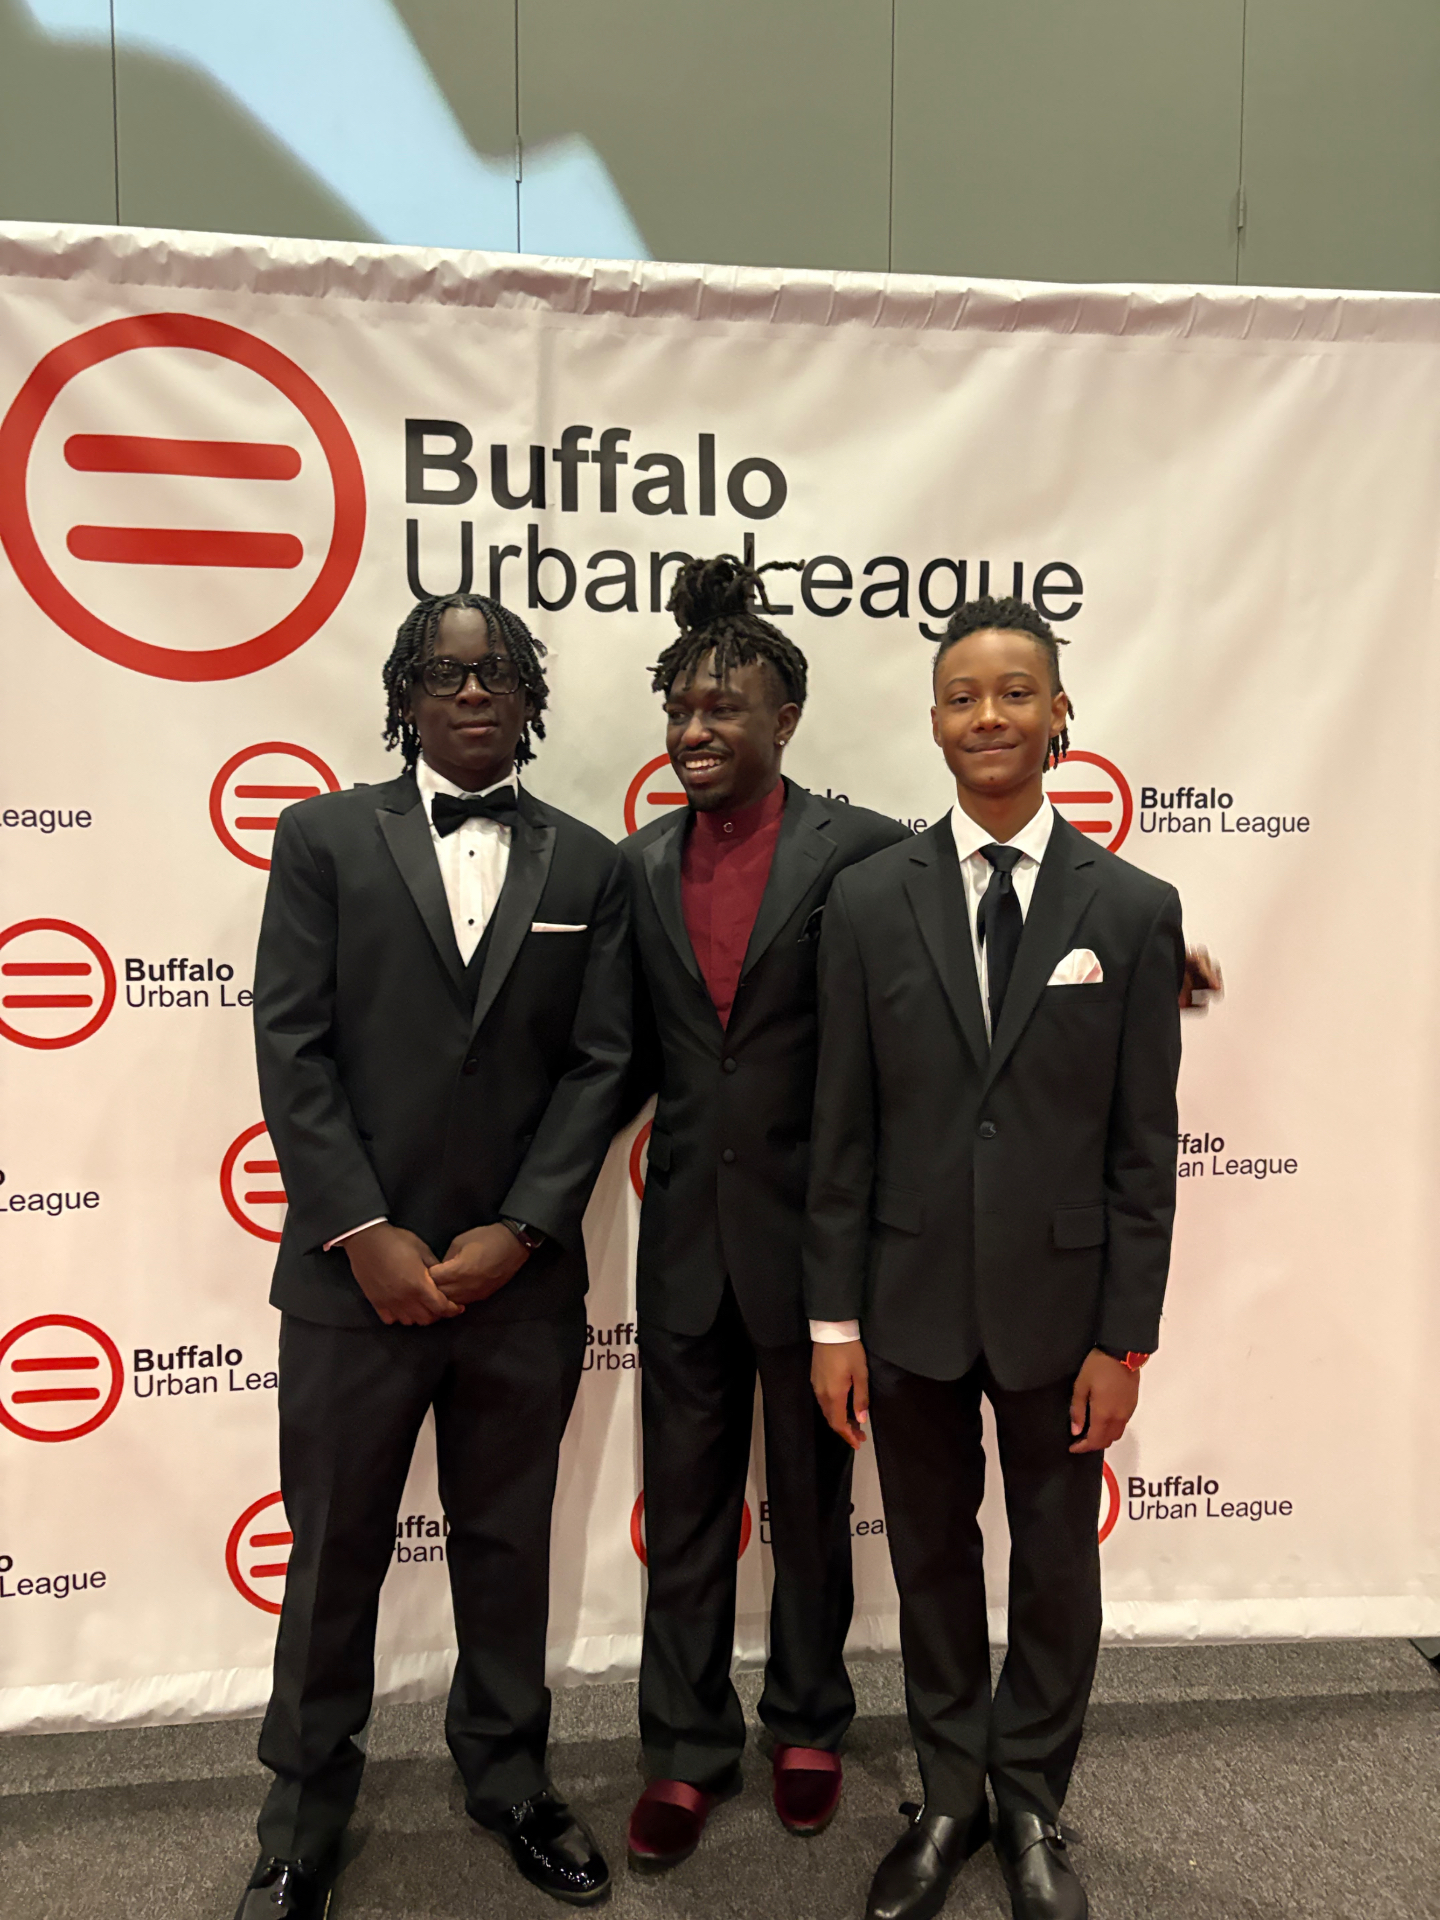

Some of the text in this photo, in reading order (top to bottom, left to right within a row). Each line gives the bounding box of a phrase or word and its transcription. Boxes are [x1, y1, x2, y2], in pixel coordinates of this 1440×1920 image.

[405, 418, 787, 519] Buffalo
[406, 519, 1084, 642] Urban League
[1141, 786, 1234, 809] Buffalo
[0, 809, 92, 834] eague
[1140, 812, 1310, 838] Urban League
[125, 958, 234, 981] Buffalo
[126, 984, 209, 1007] Urban
[1212, 1155, 1298, 1179] League
[0, 1191, 100, 1216] eague
[585, 1323, 638, 1346] Buff
[134, 1344, 242, 1372] Buffalo
[134, 1369, 278, 1398] Urban Lea
[1128, 1475, 1219, 1498] Buffalo
[1128, 1497, 1293, 1521] Urban League
[0, 1571, 106, 1598] League
